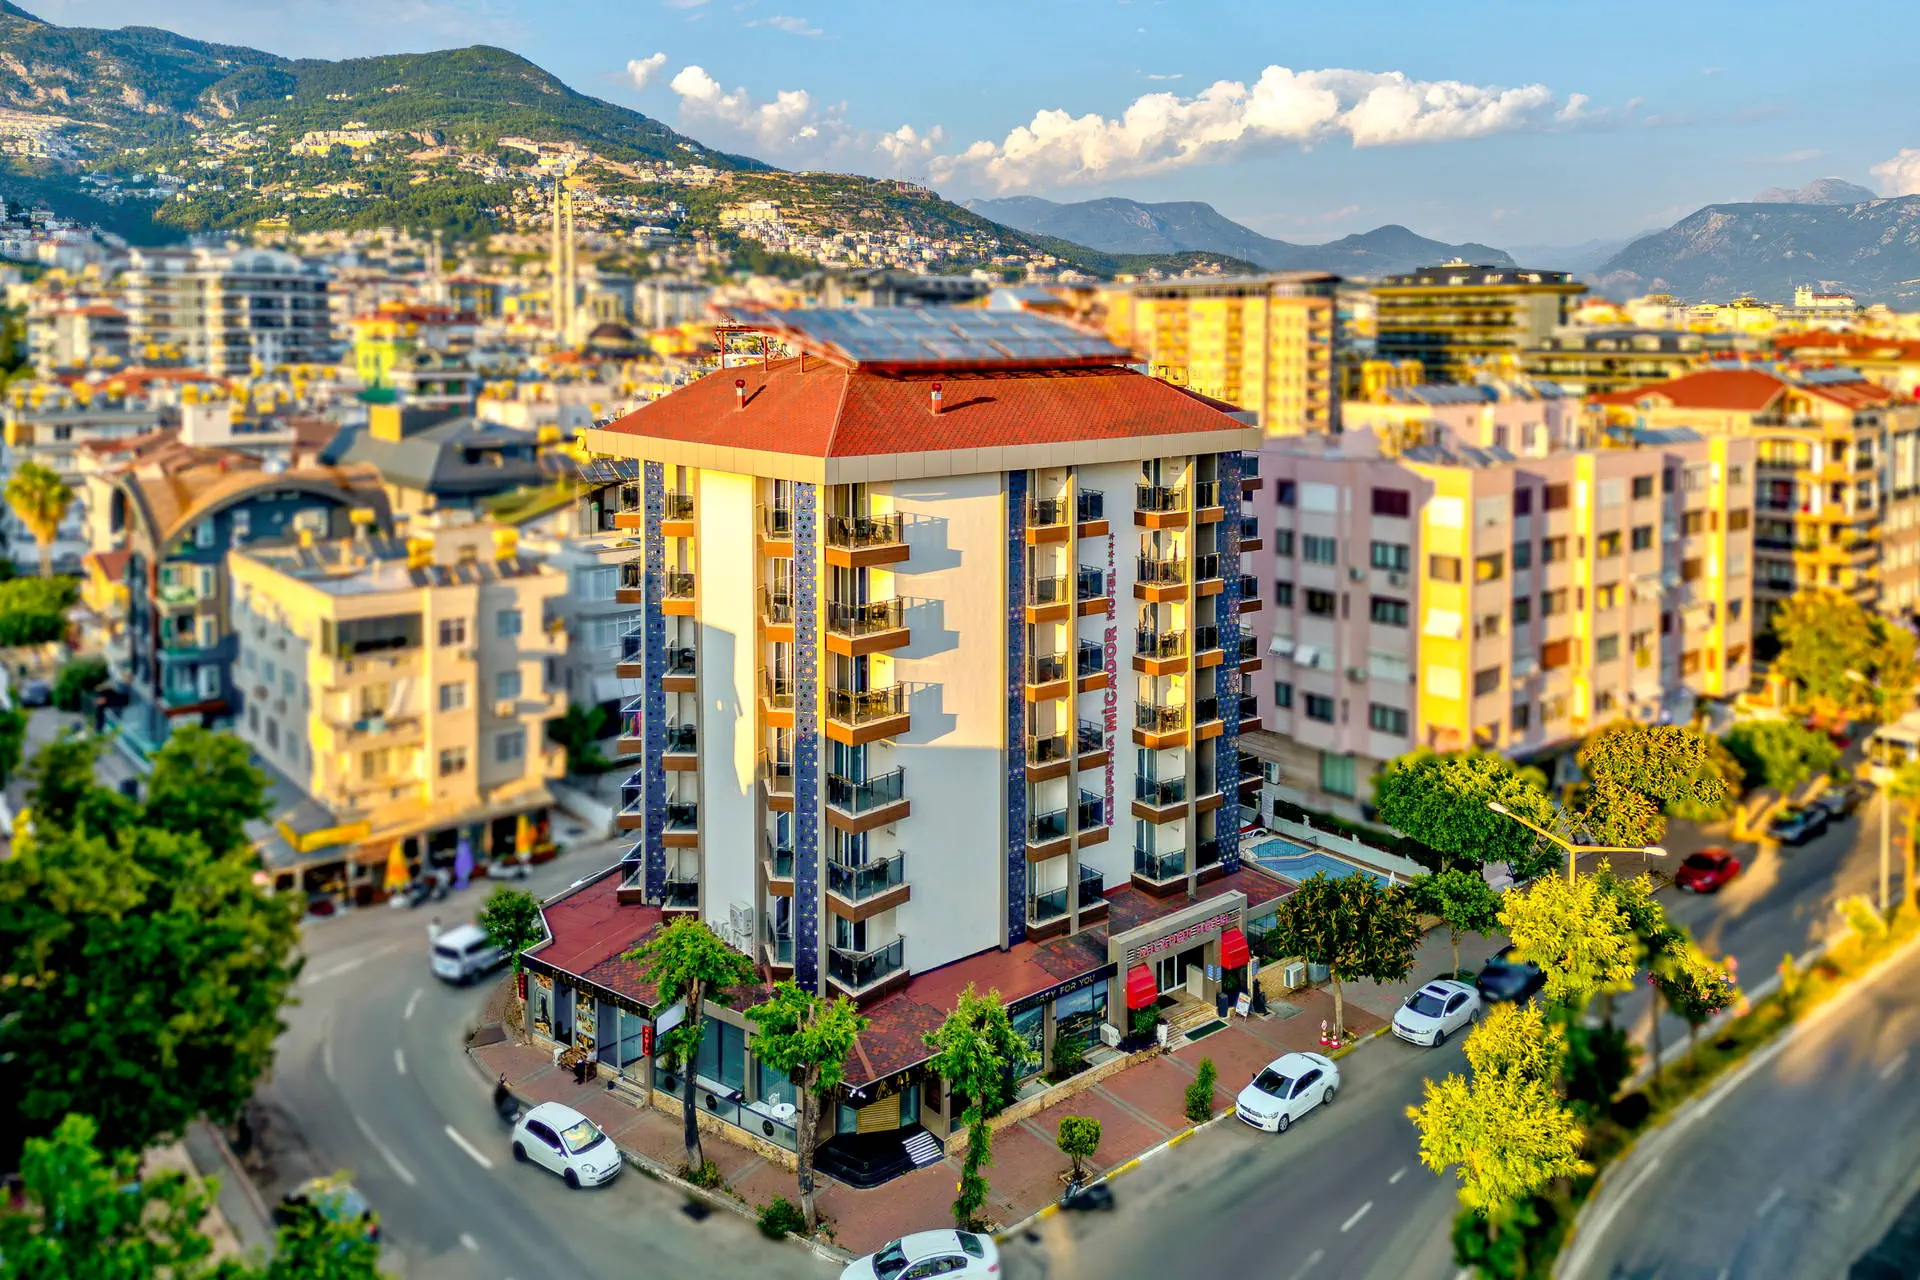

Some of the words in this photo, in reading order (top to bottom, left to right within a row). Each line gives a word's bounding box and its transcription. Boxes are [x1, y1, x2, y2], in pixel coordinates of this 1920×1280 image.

[1106, 568, 1116, 620] HOTEL
[1060, 982, 1077, 994] FOR
[1079, 974, 1096, 987] YOU
